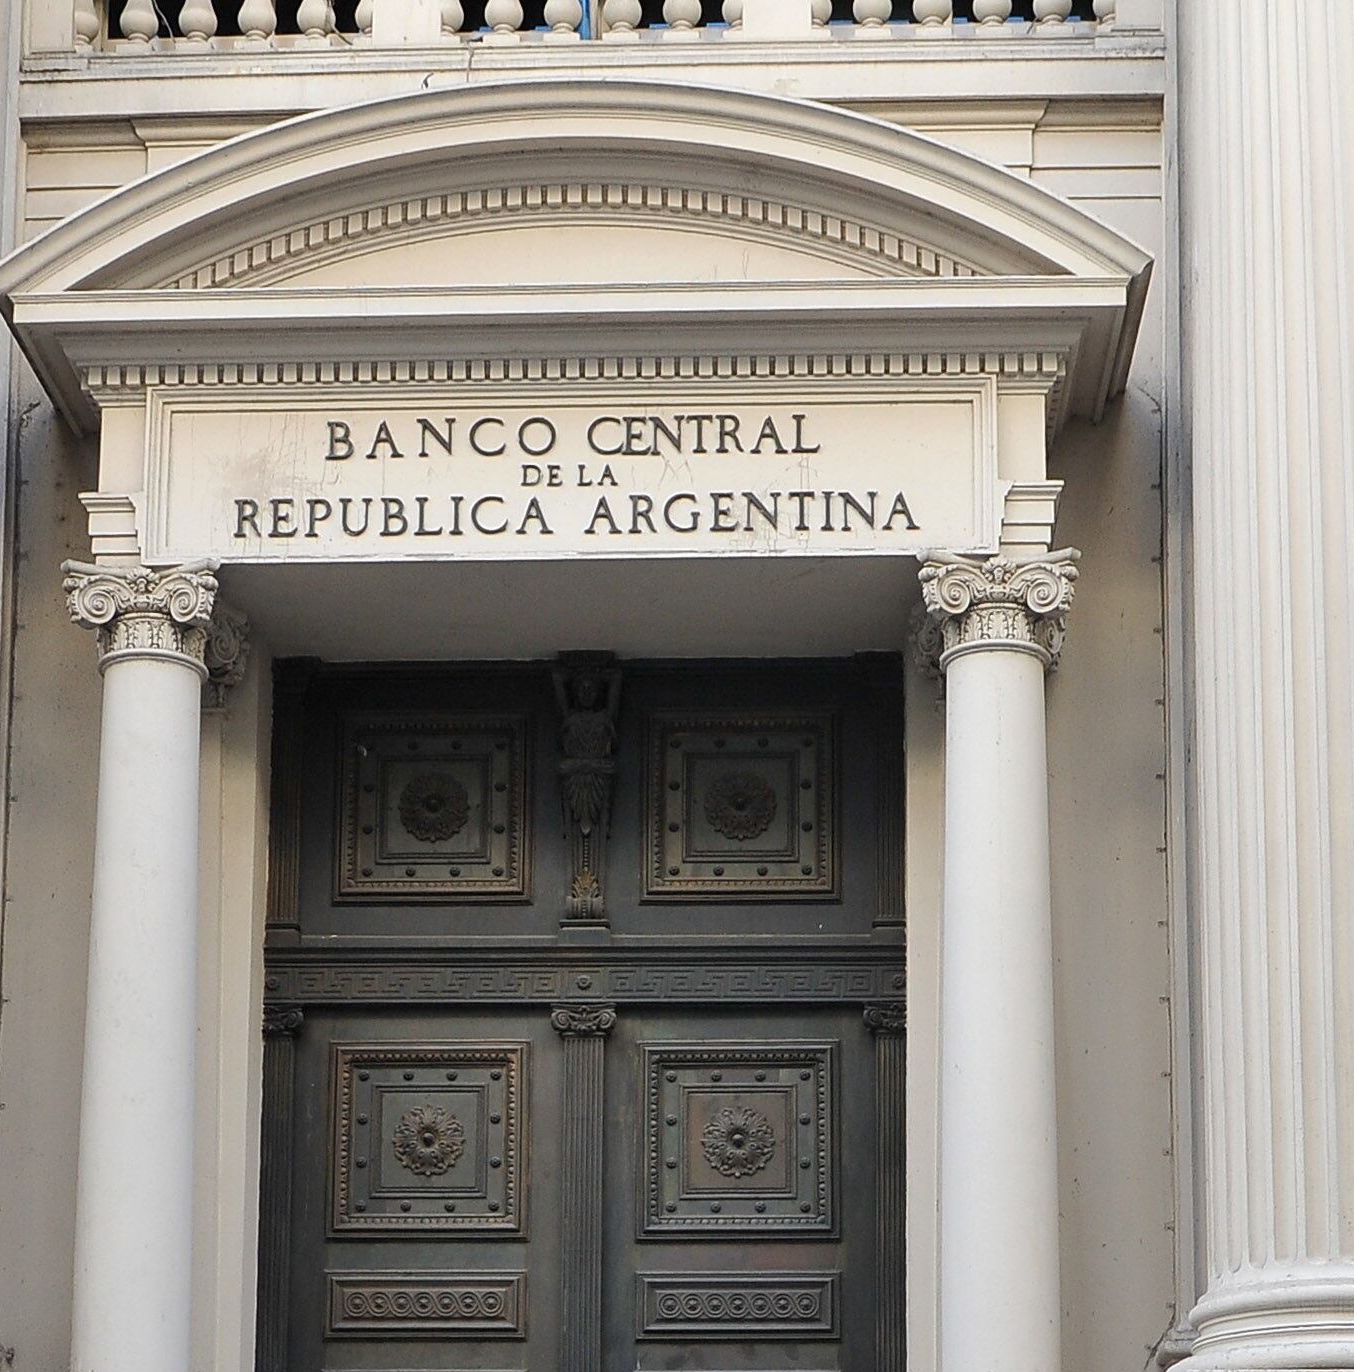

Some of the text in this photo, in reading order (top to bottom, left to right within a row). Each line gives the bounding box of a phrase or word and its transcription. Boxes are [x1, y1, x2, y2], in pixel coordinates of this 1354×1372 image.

[325, 414, 821, 460] BANCO CENTRAL
[521, 464, 619, 487] DE LA
[233, 491, 921, 538] REPUBLICA ARGENTINA
